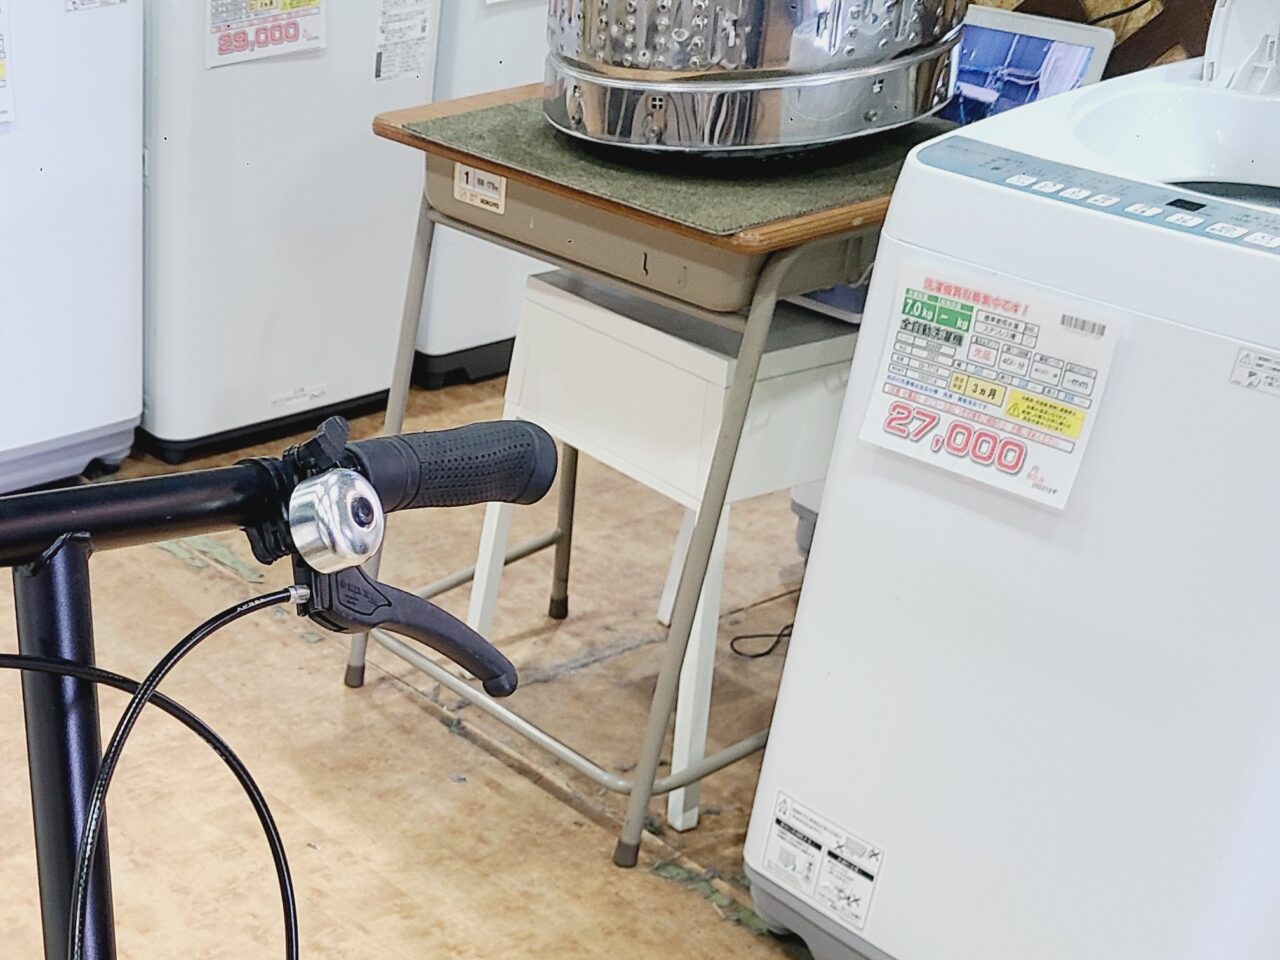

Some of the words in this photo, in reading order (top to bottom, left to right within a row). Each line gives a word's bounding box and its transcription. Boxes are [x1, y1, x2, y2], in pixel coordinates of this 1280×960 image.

[921, 308, 935, 321] kg
[899, 317, 965, 347] 全自動洗濯機
[882, 400, 1028, 476] 27,000
